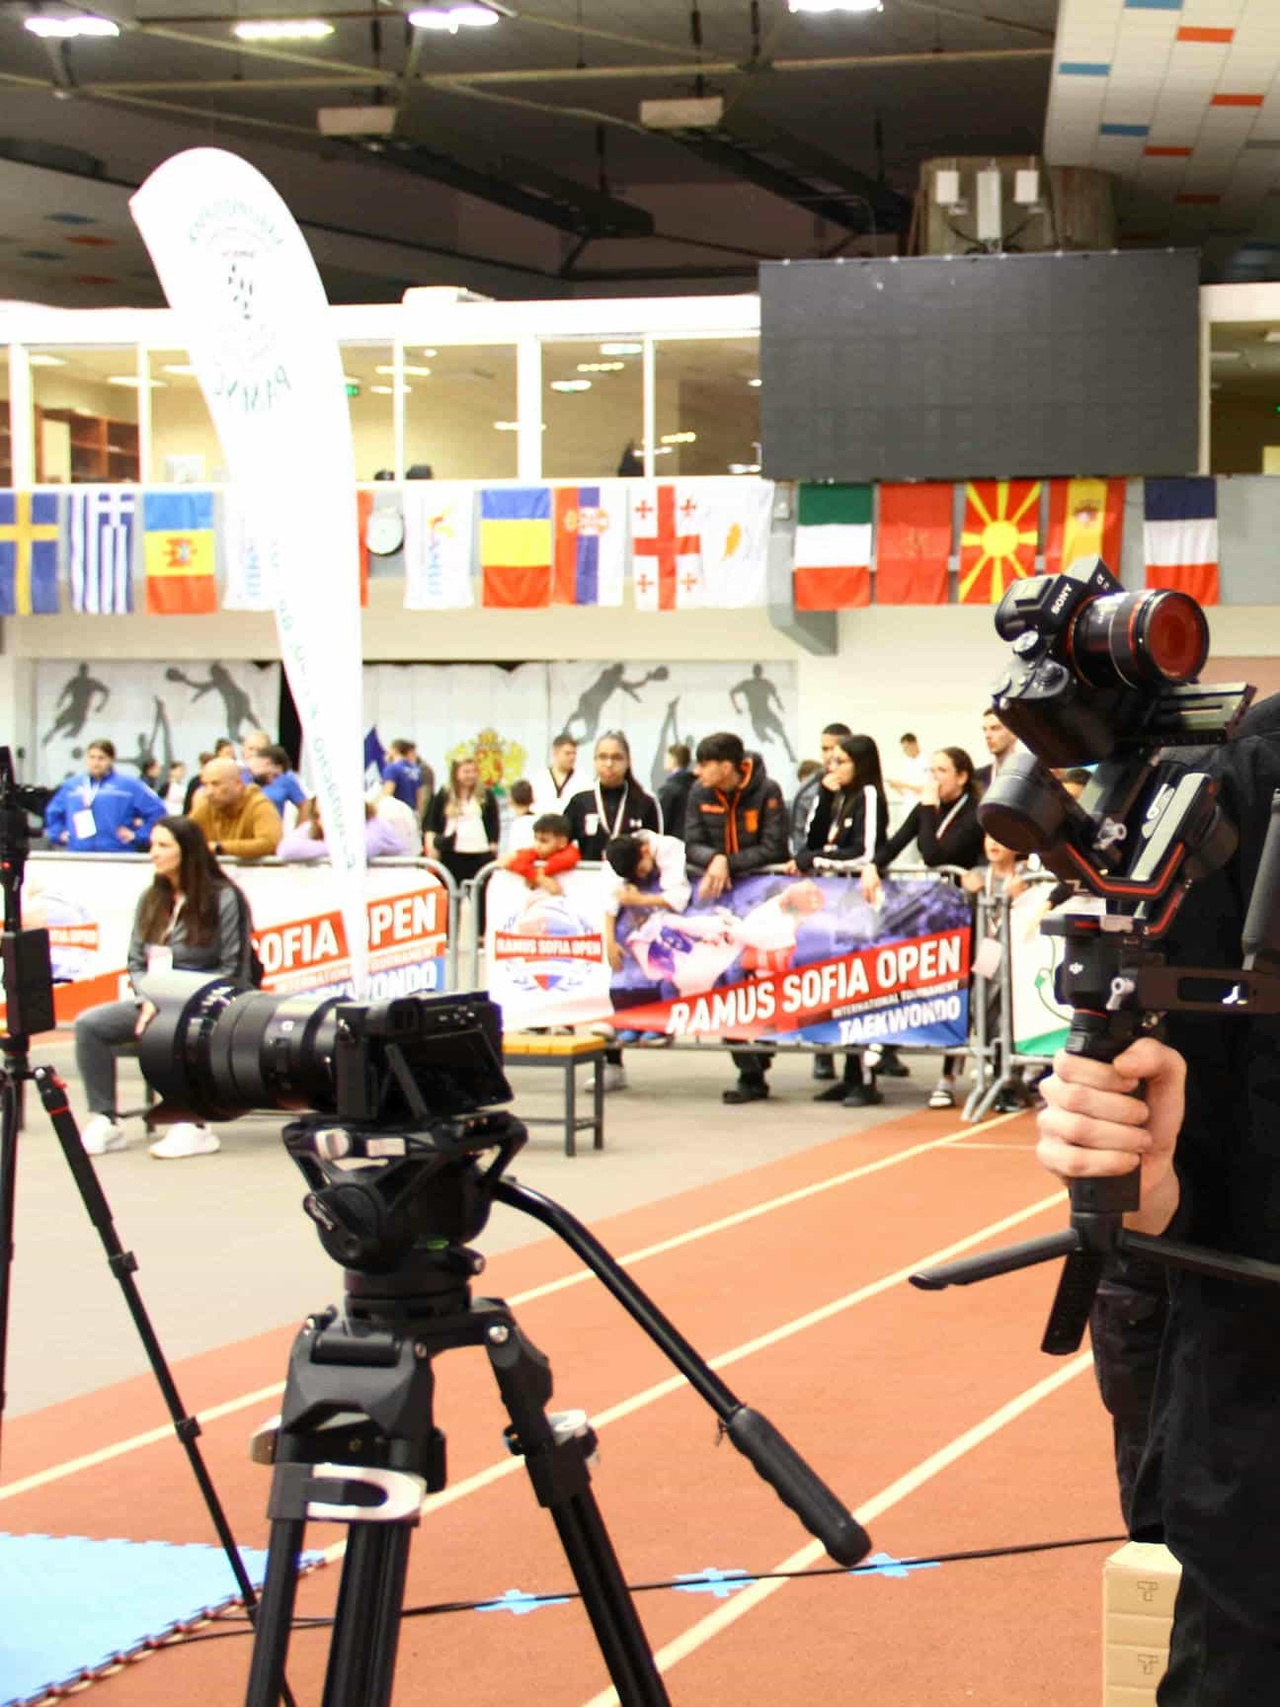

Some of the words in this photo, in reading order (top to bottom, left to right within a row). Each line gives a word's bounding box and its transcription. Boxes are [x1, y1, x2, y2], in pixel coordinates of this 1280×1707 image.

[1051, 583, 1073, 616] SONY
[367, 893, 437, 946] PEN
[666, 982, 775, 1034] RAMUS
[782, 958, 869, 1013] SOFIA
[876, 936, 960, 988] OPEN
[838, 995, 960, 1045] TAEKWONDO
